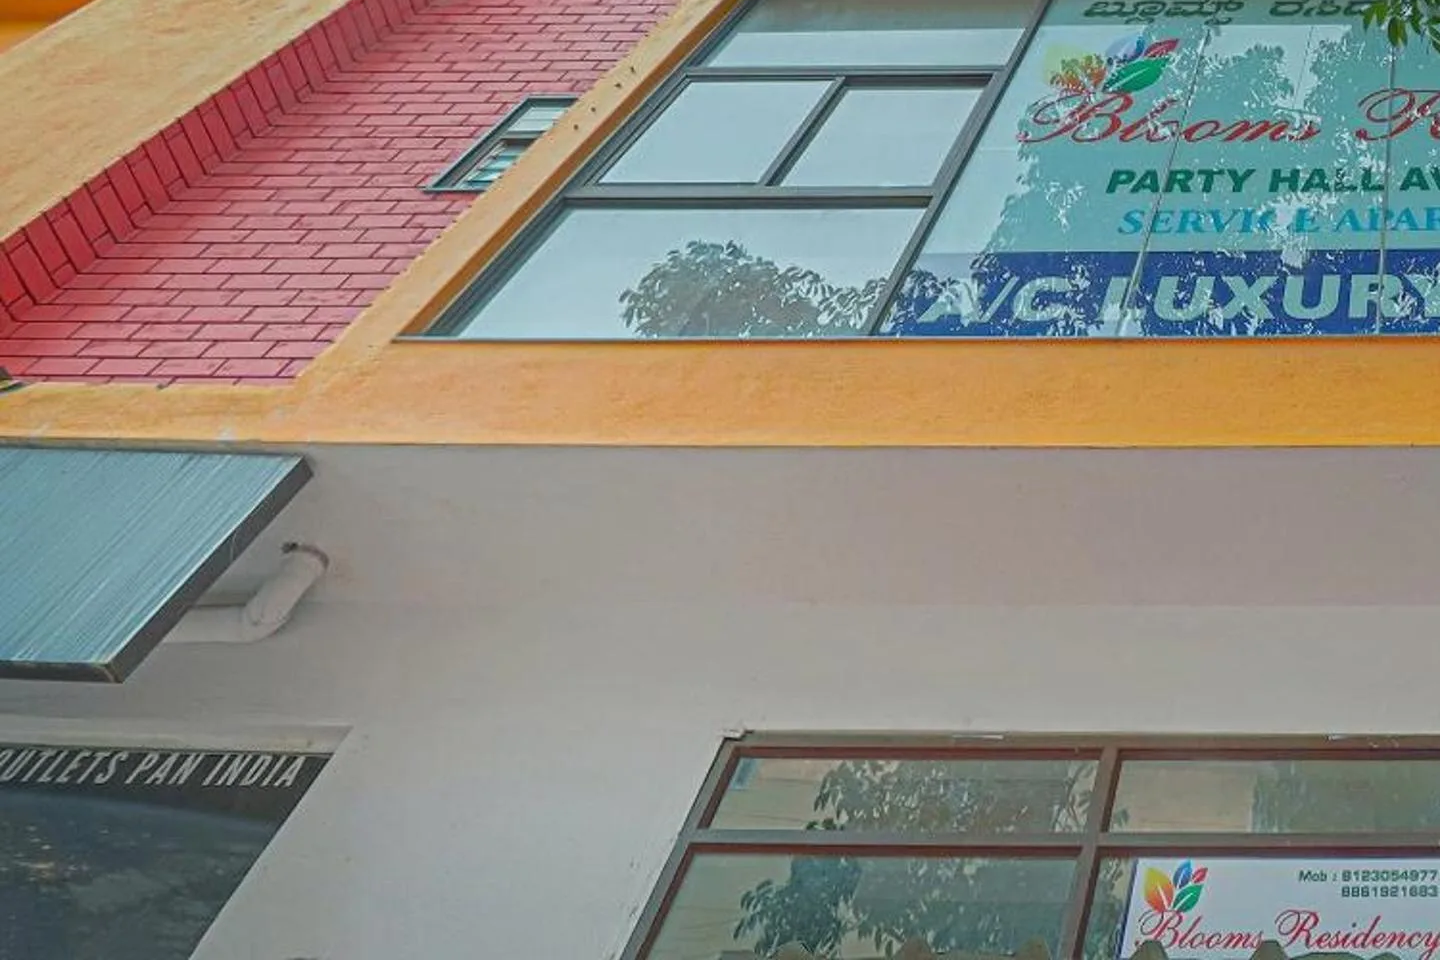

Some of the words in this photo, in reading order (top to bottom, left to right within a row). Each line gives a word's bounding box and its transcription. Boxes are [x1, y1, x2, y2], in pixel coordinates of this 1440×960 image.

[1015, 90, 1322, 143] Blooms
[1105, 168, 1256, 193] PARTY
[1268, 167, 1385, 194] HALL
[917, 276, 1077, 324] A/C
[124, 751, 205, 785] PAN
[201, 753, 306, 787] INDIA
[1298, 869, 1328, 882] Mob
[1341, 869, 1439, 882] 8123054977
[1341, 885, 1439, 898] 8861921683
[1136, 909, 1264, 950] Blooms
